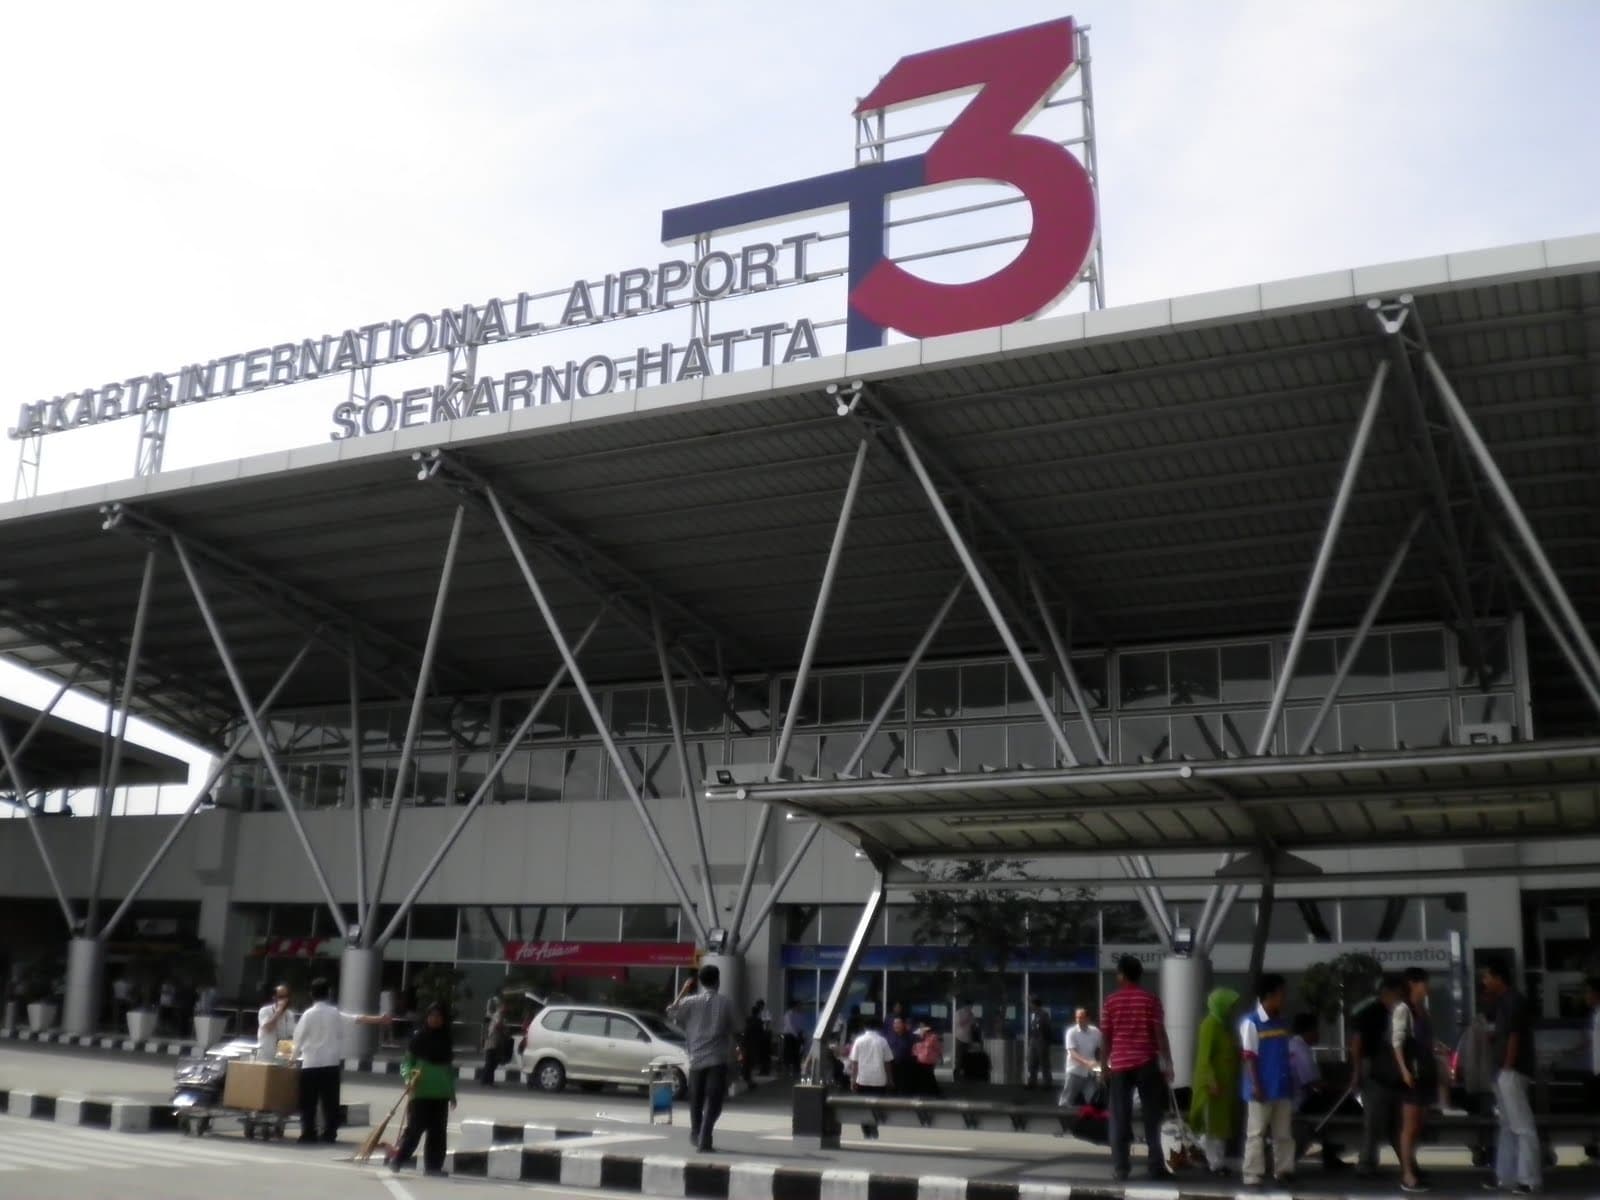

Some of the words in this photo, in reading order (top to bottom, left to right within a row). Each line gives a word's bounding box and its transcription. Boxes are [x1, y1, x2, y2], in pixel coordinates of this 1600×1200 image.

[176, 292, 542, 404] INTERNATIONAL
[560, 232, 819, 327] AIRPORT
[330, 318, 823, 440] SOEKARNO-HATTA
